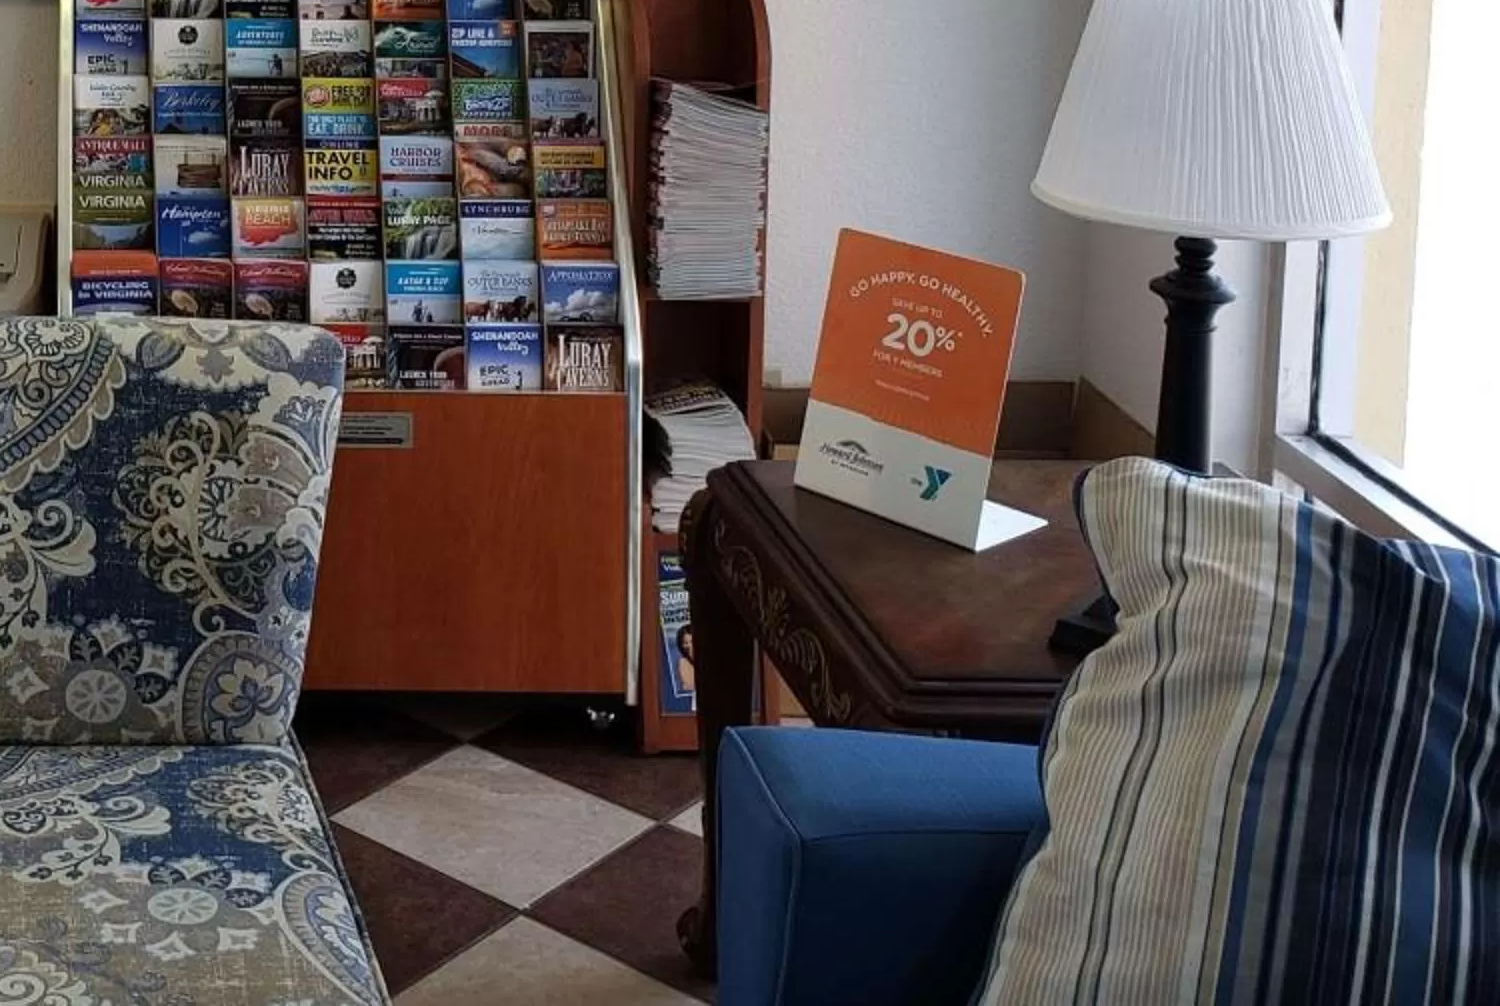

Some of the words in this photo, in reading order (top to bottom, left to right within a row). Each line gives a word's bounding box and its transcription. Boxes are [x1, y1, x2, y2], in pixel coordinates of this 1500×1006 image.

[87, 54, 115, 65] EPIC
[307, 151, 370, 165] TRAVEL
[390, 147, 442, 158] HARBOR
[240, 145, 290, 182] LURAY
[389, 157, 442, 168] CRUISES
[309, 167, 353, 181] INFO
[79, 175, 146, 189] VIRGINIA
[79, 195, 146, 209] VIRGINIA
[161, 203, 222, 222] Hampton
[244, 214, 291, 226] BEACH
[81, 280, 149, 290] BICYCLING
[95, 289, 153, 300] VIRGINIA
[850, 278, 870, 298] GO
[870, 270, 917, 286] HAPPY.
[919, 274, 940, 290] GO
[941, 283, 994, 337] HEALTHY.
[471, 331, 539, 342] SHENANDOAH
[557, 333, 612, 369] LURAY
[479, 365, 509, 376] EPIC
[556, 367, 611, 392] CAVERNS
